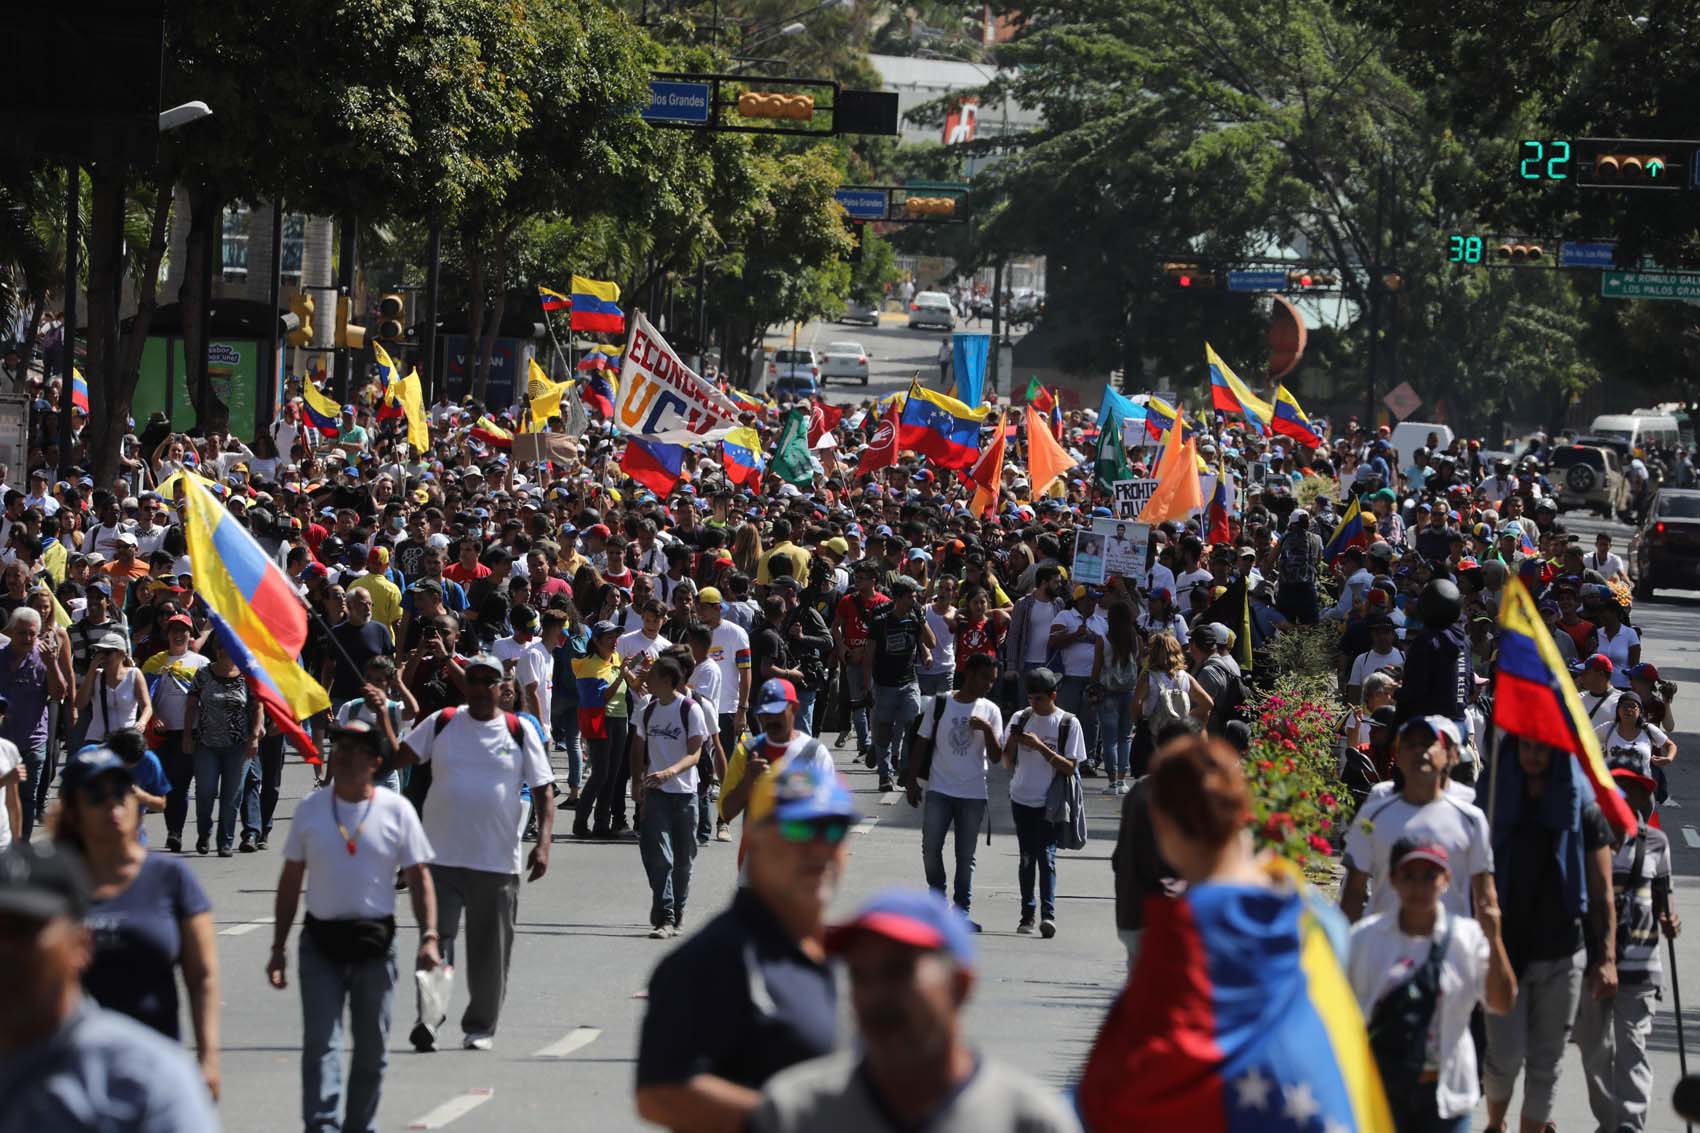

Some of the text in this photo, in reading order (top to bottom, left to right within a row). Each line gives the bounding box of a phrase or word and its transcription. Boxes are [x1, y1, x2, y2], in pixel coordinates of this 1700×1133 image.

[648, 92, 704, 107] alos Grandes
[1521, 141, 1570, 178] 22
[1449, 235, 1482, 263] 38
[1622, 284, 1641, 294] LOS
[1643, 285, 1674, 297] PALOS
[621, 372, 717, 435] UCV
[1456, 676, 1466, 703] KLEIN
